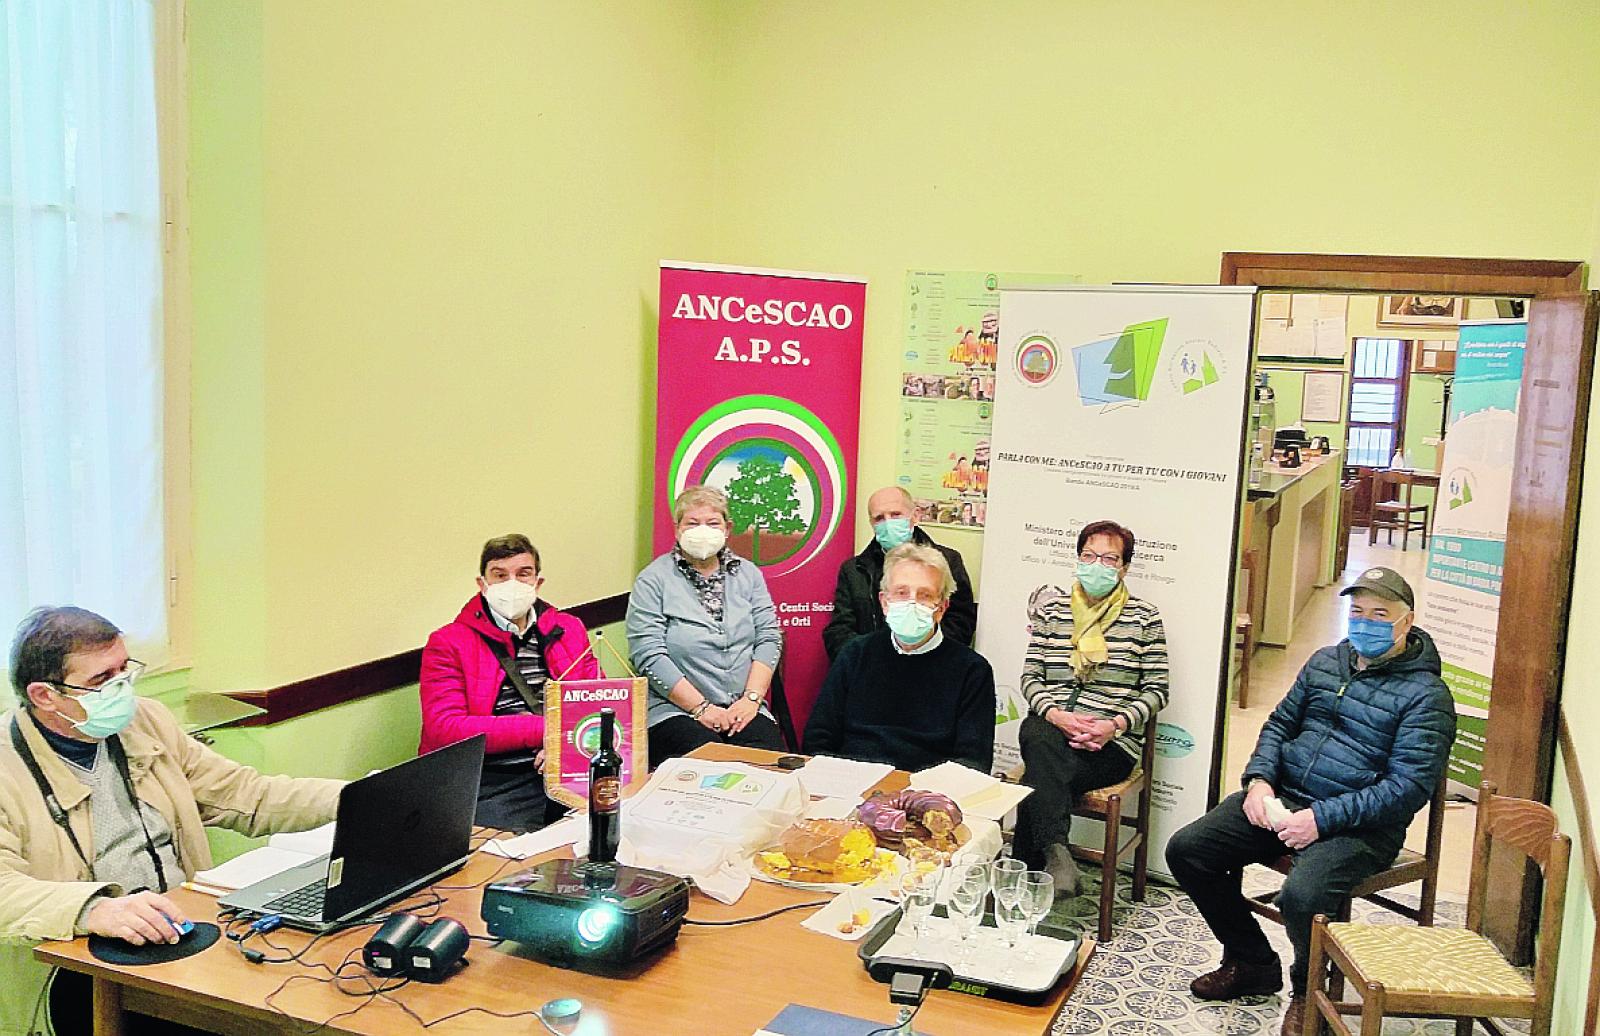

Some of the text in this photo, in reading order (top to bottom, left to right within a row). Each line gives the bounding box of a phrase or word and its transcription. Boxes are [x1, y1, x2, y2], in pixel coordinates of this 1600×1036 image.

[672, 293, 853, 329] ANCeSCAO
[714, 336, 810, 366] A.P.S.
[997, 452, 1024, 462] PARLA
[1024, 455, 1040, 464] CON
[1112, 463, 1125, 472] TU
[1125, 464, 1143, 474] PER
[1145, 467, 1160, 476] TU
[1160, 468, 1179, 477] CON
[1186, 471, 1227, 482] GIOVANI
[1025, 523, 1064, 536] Ministero
[779, 602, 810, 612] Centri
[791, 616, 811, 627] Orti
[563, 688, 629, 702] ANCeSCAO
